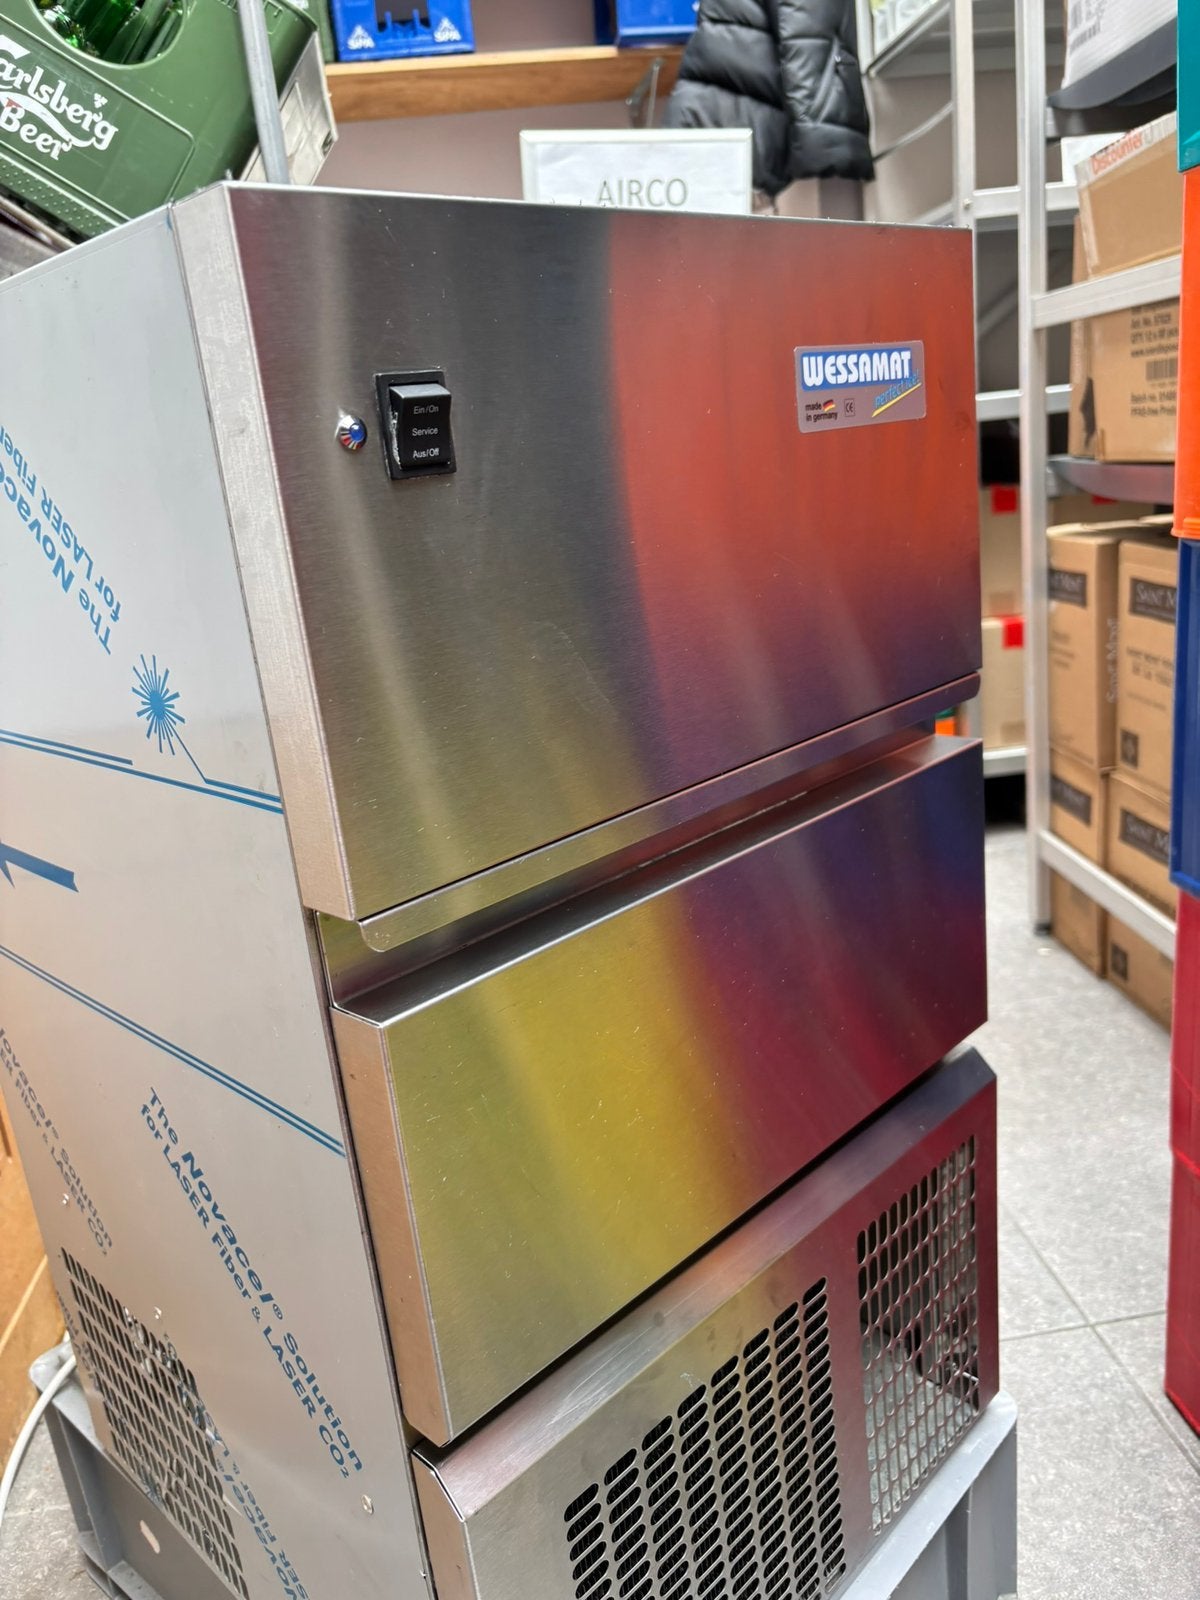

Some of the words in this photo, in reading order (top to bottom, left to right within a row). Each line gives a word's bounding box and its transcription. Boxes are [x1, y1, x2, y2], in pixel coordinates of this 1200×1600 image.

[0, 104, 72, 160] Beer
[597, 178, 688, 207] AIRCO
[802, 350, 911, 387] WESSAMAT
[412, 427, 438, 436] Service
[805, 402, 822, 411] made
[806, 414, 813, 422] in
[813, 411, 838, 423] germany
[412, 447, 440, 458] Aus/Off
[41, 486, 93, 581] LASER
[78, 588, 111, 655] The
[94, 576, 121, 622] for
[50, 1147, 86, 1213] LASER
[60, 1148, 113, 1248] Solution
[141, 1104, 163, 1140] for
[163, 1144, 210, 1230] LASER
[211, 1232, 252, 1300] Fiber
[252, 1306, 261, 1324] &
[263, 1325, 316, 1419] LASER
[150, 1087, 179, 1145] The
[284, 1332, 363, 1471] Solution
[279, 1549, 310, 1600] SER
